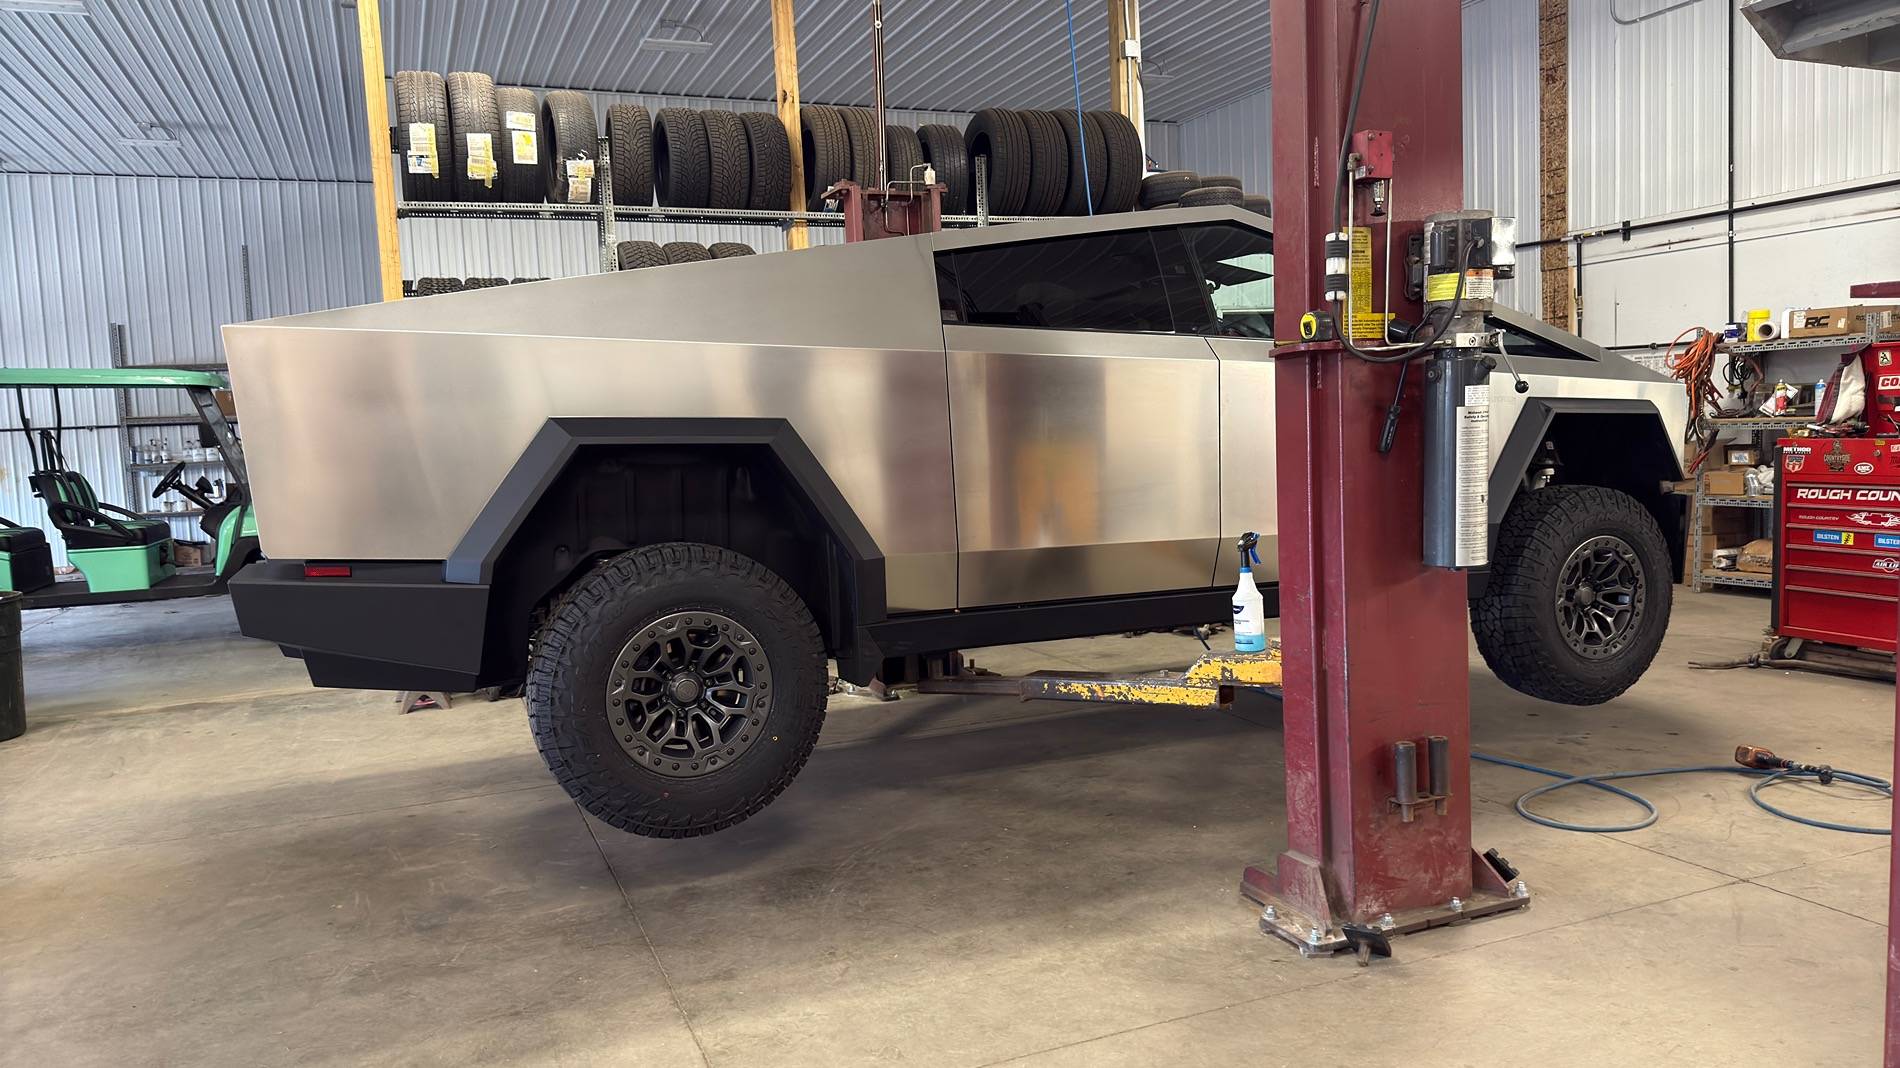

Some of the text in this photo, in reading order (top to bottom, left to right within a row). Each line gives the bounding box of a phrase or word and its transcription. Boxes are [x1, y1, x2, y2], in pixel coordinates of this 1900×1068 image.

[1805, 315, 1830, 328] RC
[1881, 377, 1900, 387] CO
[1796, 488, 1852, 500] ROUGH
[1816, 532, 1840, 541] BILSTEIN
